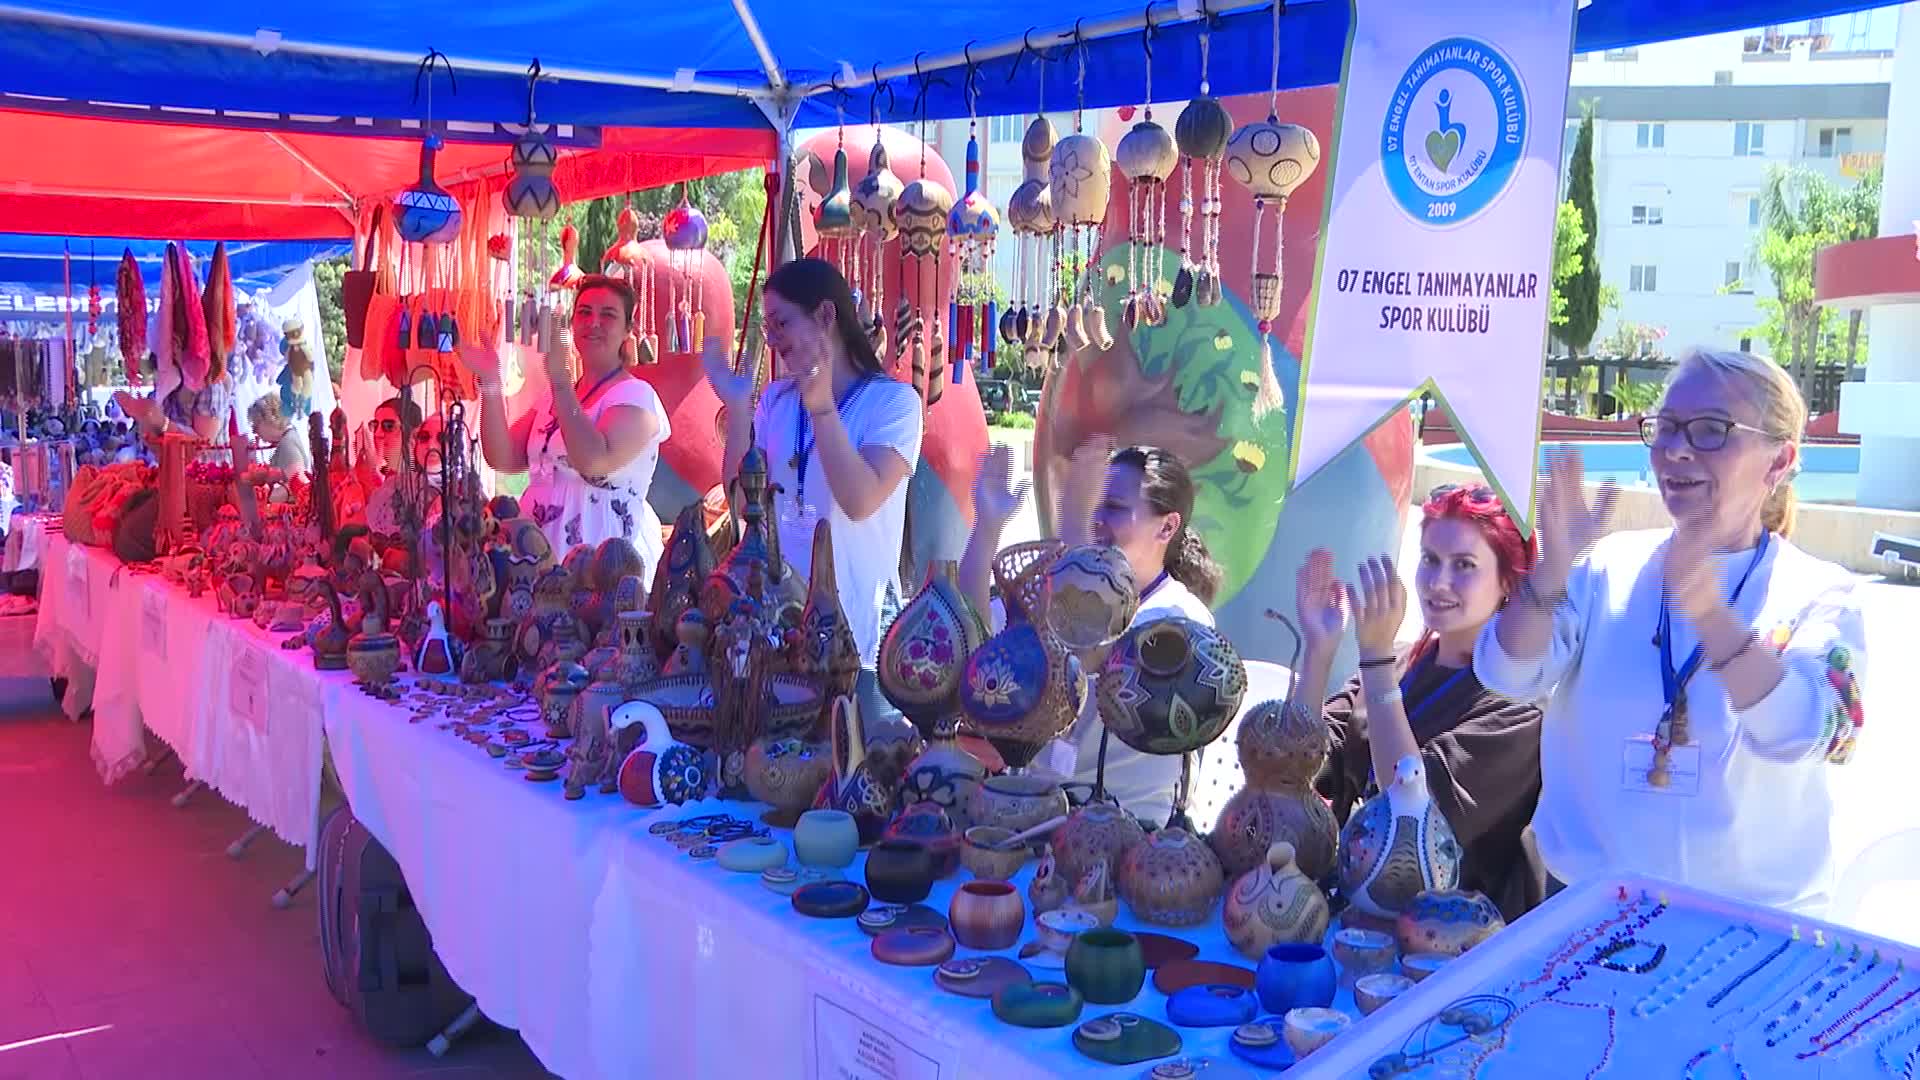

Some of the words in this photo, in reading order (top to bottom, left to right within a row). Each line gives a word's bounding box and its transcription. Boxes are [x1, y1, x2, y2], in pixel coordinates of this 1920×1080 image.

[1406, 46, 1480, 89] TANIMAYANLAR
[1479, 56, 1507, 89] SPOR
[1389, 91, 1409, 132] ENGEL
[1500, 84, 1521, 144] KULÜBÜ
[1387, 136, 1398, 152] 07
[1427, 201, 1457, 218] 2009
[1337, 269, 1359, 292] 07
[1362, 270, 1412, 296] ENGEL
[1417, 272, 1538, 299] TANIMAYANLAR
[1379, 305, 1423, 332] SPOR
[1427, 303, 1490, 334] KULÜBÜ
